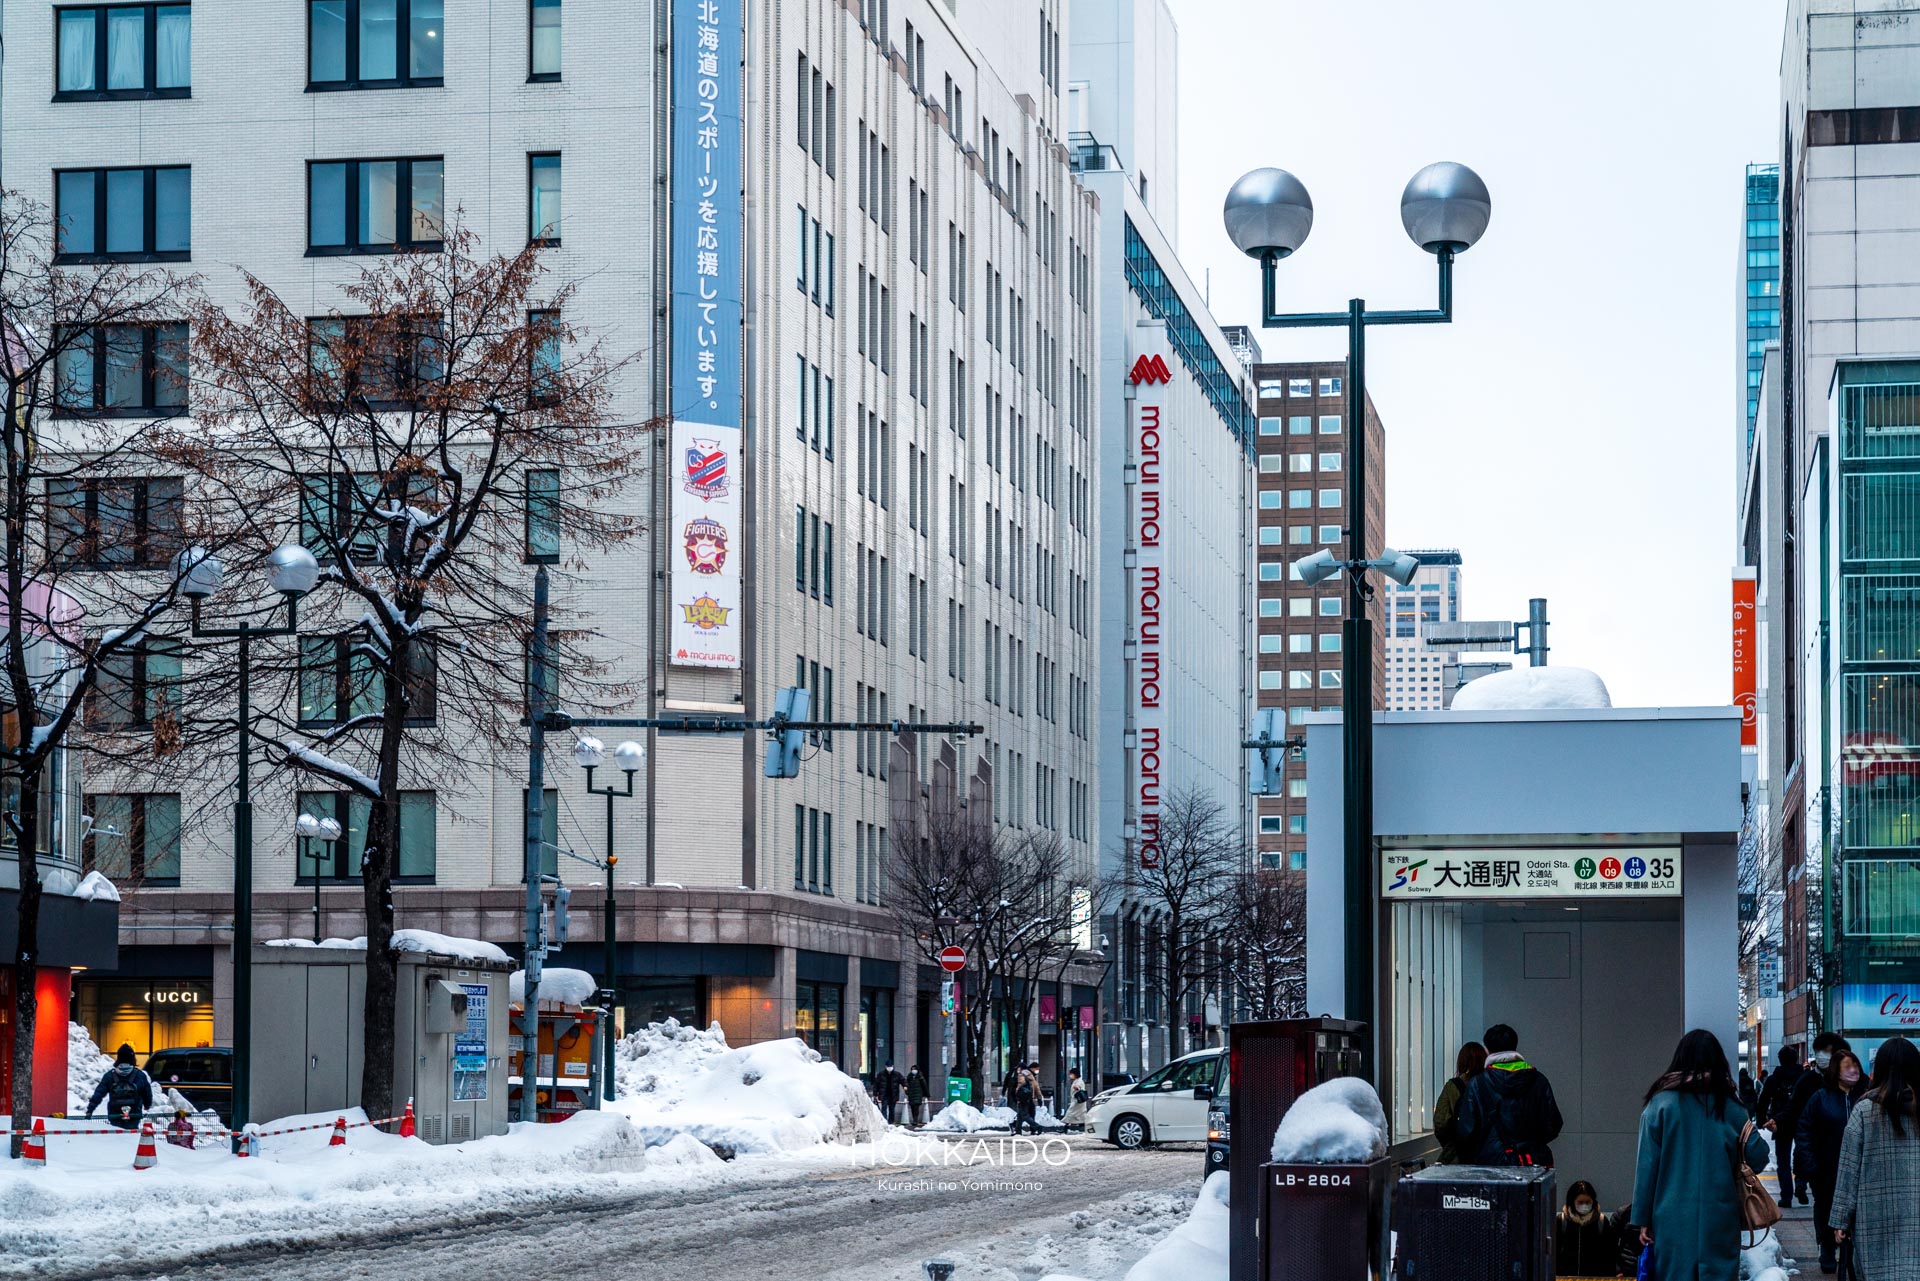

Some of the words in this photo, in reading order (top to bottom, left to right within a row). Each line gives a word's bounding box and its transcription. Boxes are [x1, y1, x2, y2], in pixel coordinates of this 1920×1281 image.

[697, 1, 719, 411] 北海道のスポーツを応援しています。
[1141, 406, 1160, 483] marui
[1141, 491, 1160, 546] imai
[685, 524, 727, 540] FIGHTERS
[1141, 567, 1160, 644] marui
[1734, 600, 1754, 620] le
[1734, 627, 1747, 673] trois
[1141, 652, 1160, 708] imai
[1141, 728, 1160, 806] marui
[1387, 856, 1410, 864] 地下鉄
[1526, 860, 1551, 869] Odori
[1553, 860, 1570, 869] Sta.
[1582, 859, 1590, 868] N
[1606, 859, 1614, 867] T
[1631, 858, 1639, 867] H
[1433, 860, 1521, 888] 大通駅
[1527, 870, 1552, 878] 大通站
[1579, 868, 1592, 877] 07
[1604, 868, 1617, 877] 09
[1629, 867, 1642, 876] 08
[1650, 858, 1674, 879] 35
[1527, 879, 1558, 888] 오도리역
[1574, 881, 1597, 890] 南北線
[1600, 881, 1623, 890] 東西線
[1625, 881, 1648, 889] 東豊線
[1651, 880, 1674, 889] 出入口
[1880, 992, 1920, 1016] Chan
[1275, 1174, 1351, 1186] LB-2604
[1444, 1196, 1488, 1208] MP-184
